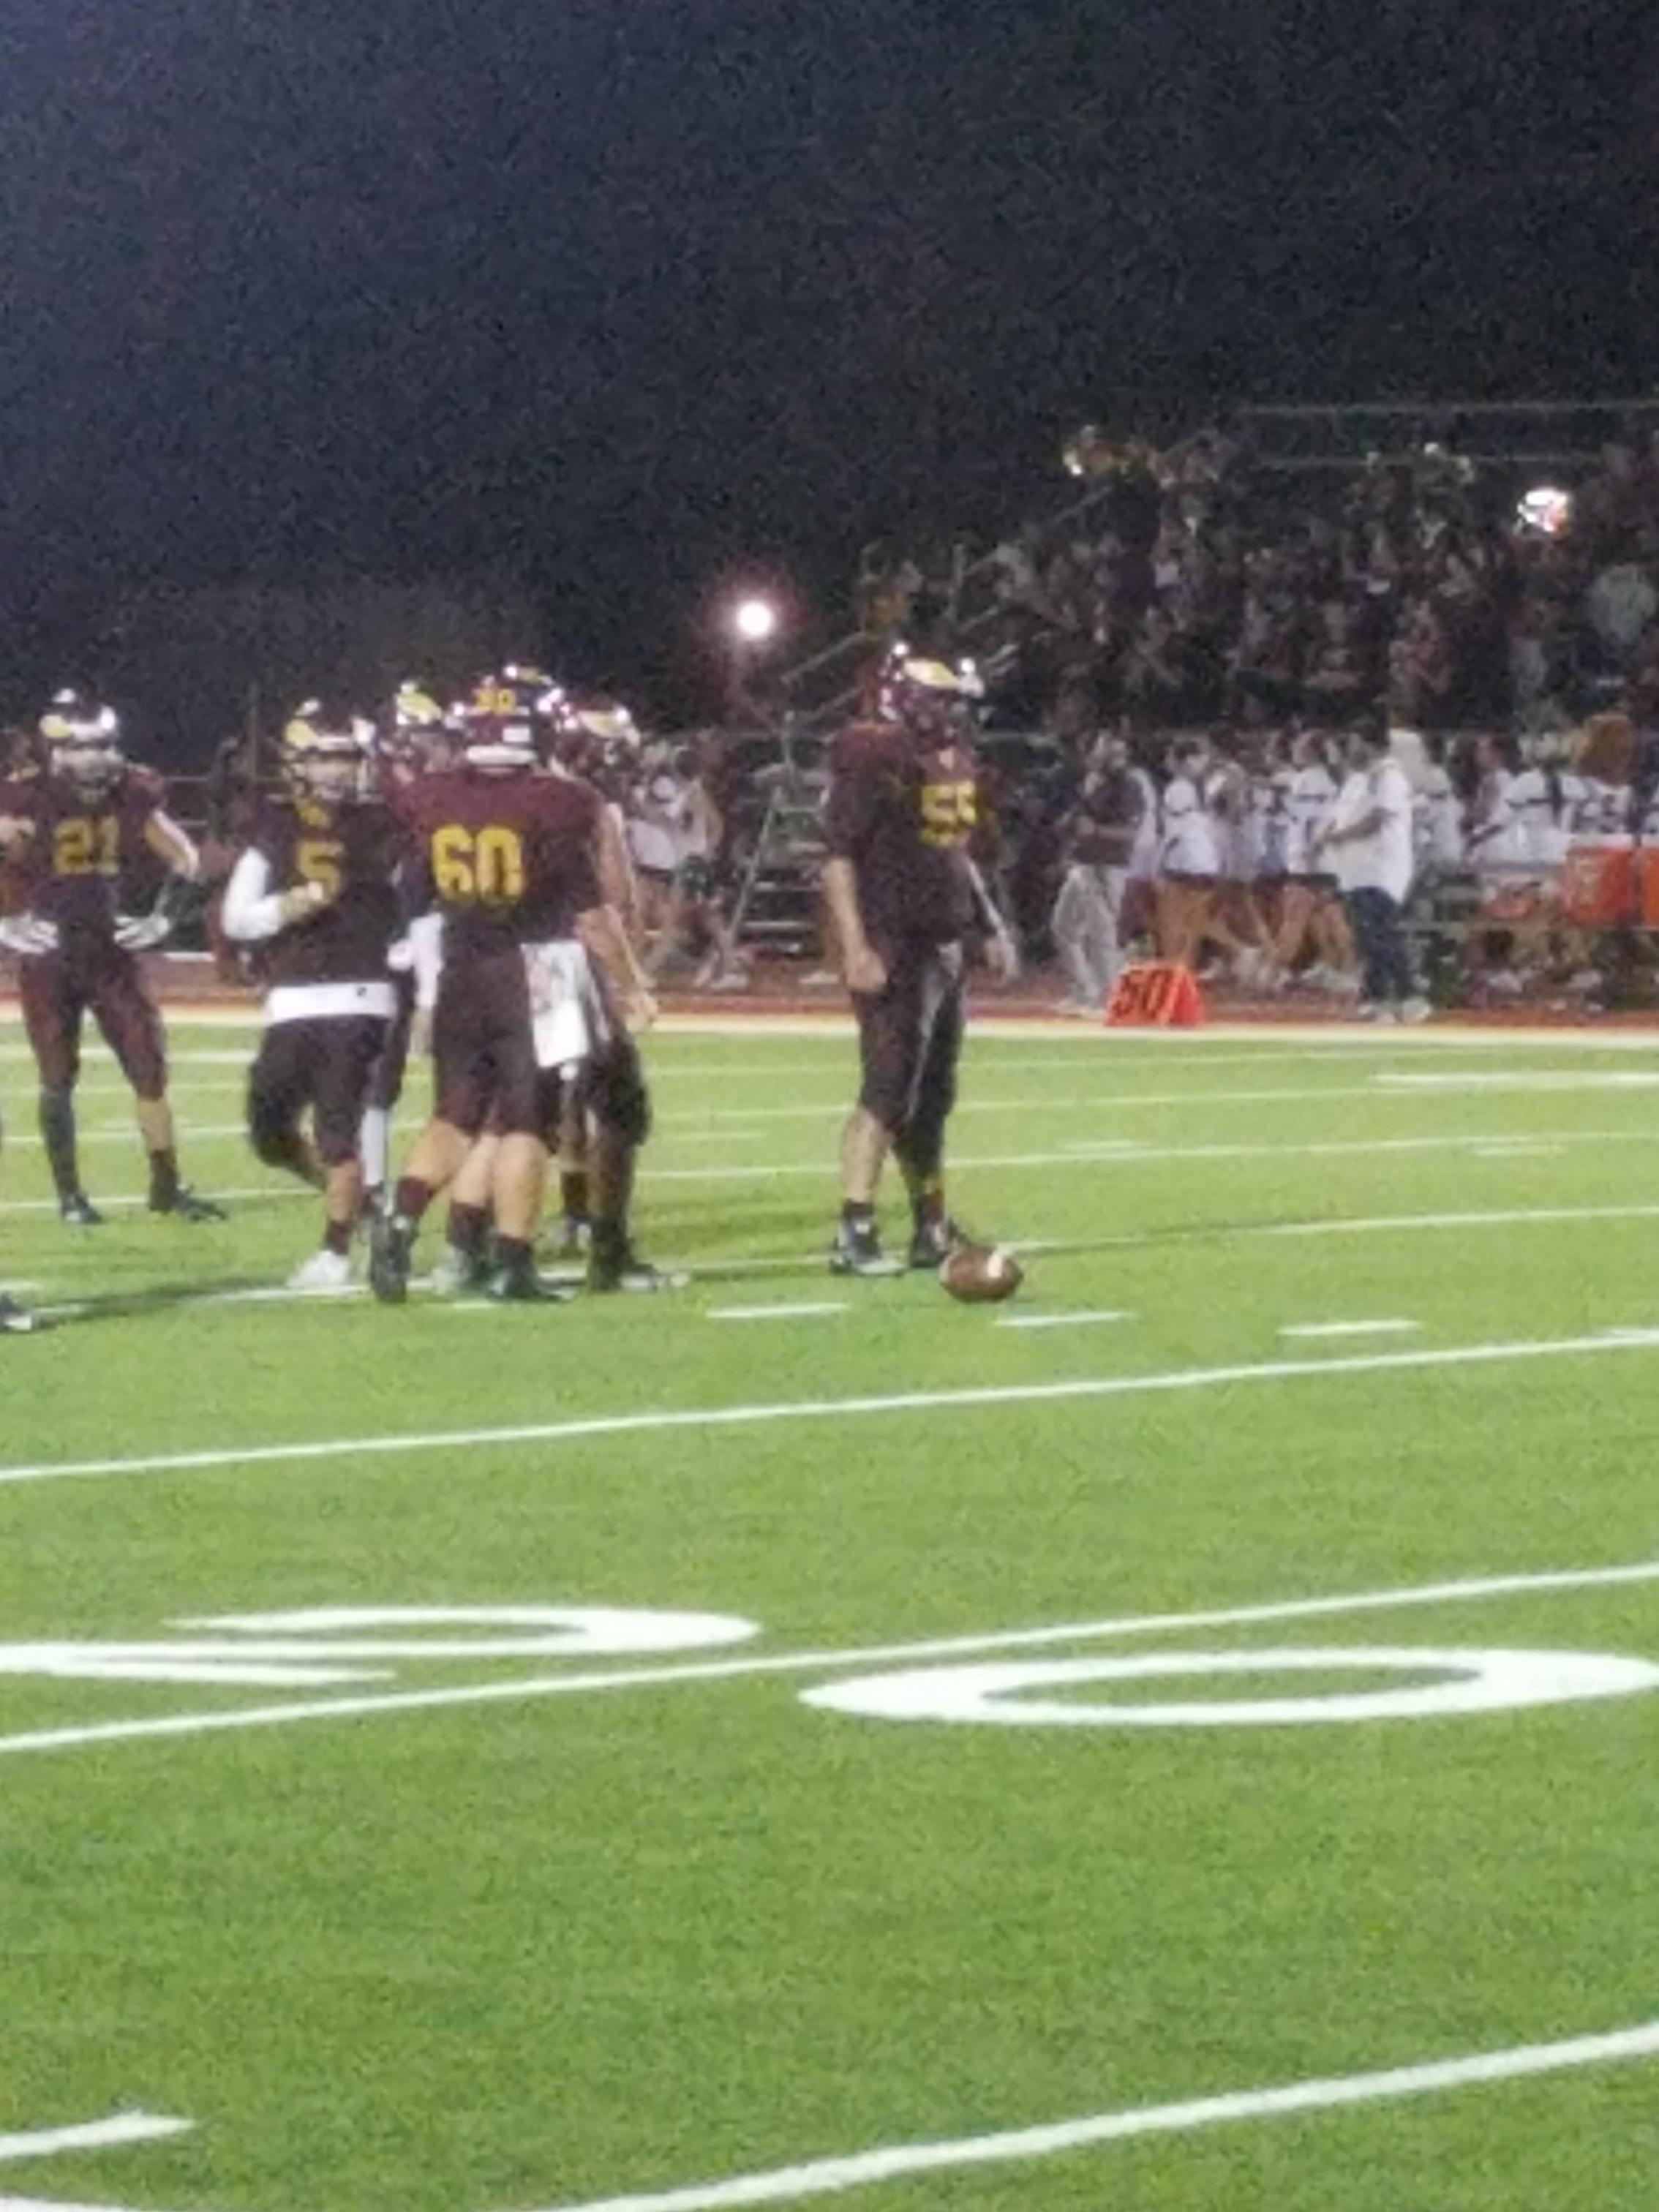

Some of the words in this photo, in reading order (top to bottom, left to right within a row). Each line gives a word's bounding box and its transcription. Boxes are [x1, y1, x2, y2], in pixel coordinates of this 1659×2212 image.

[52, 816, 120, 875] 21
[297, 840, 344, 903] 5
[432, 824, 523, 906] 60
